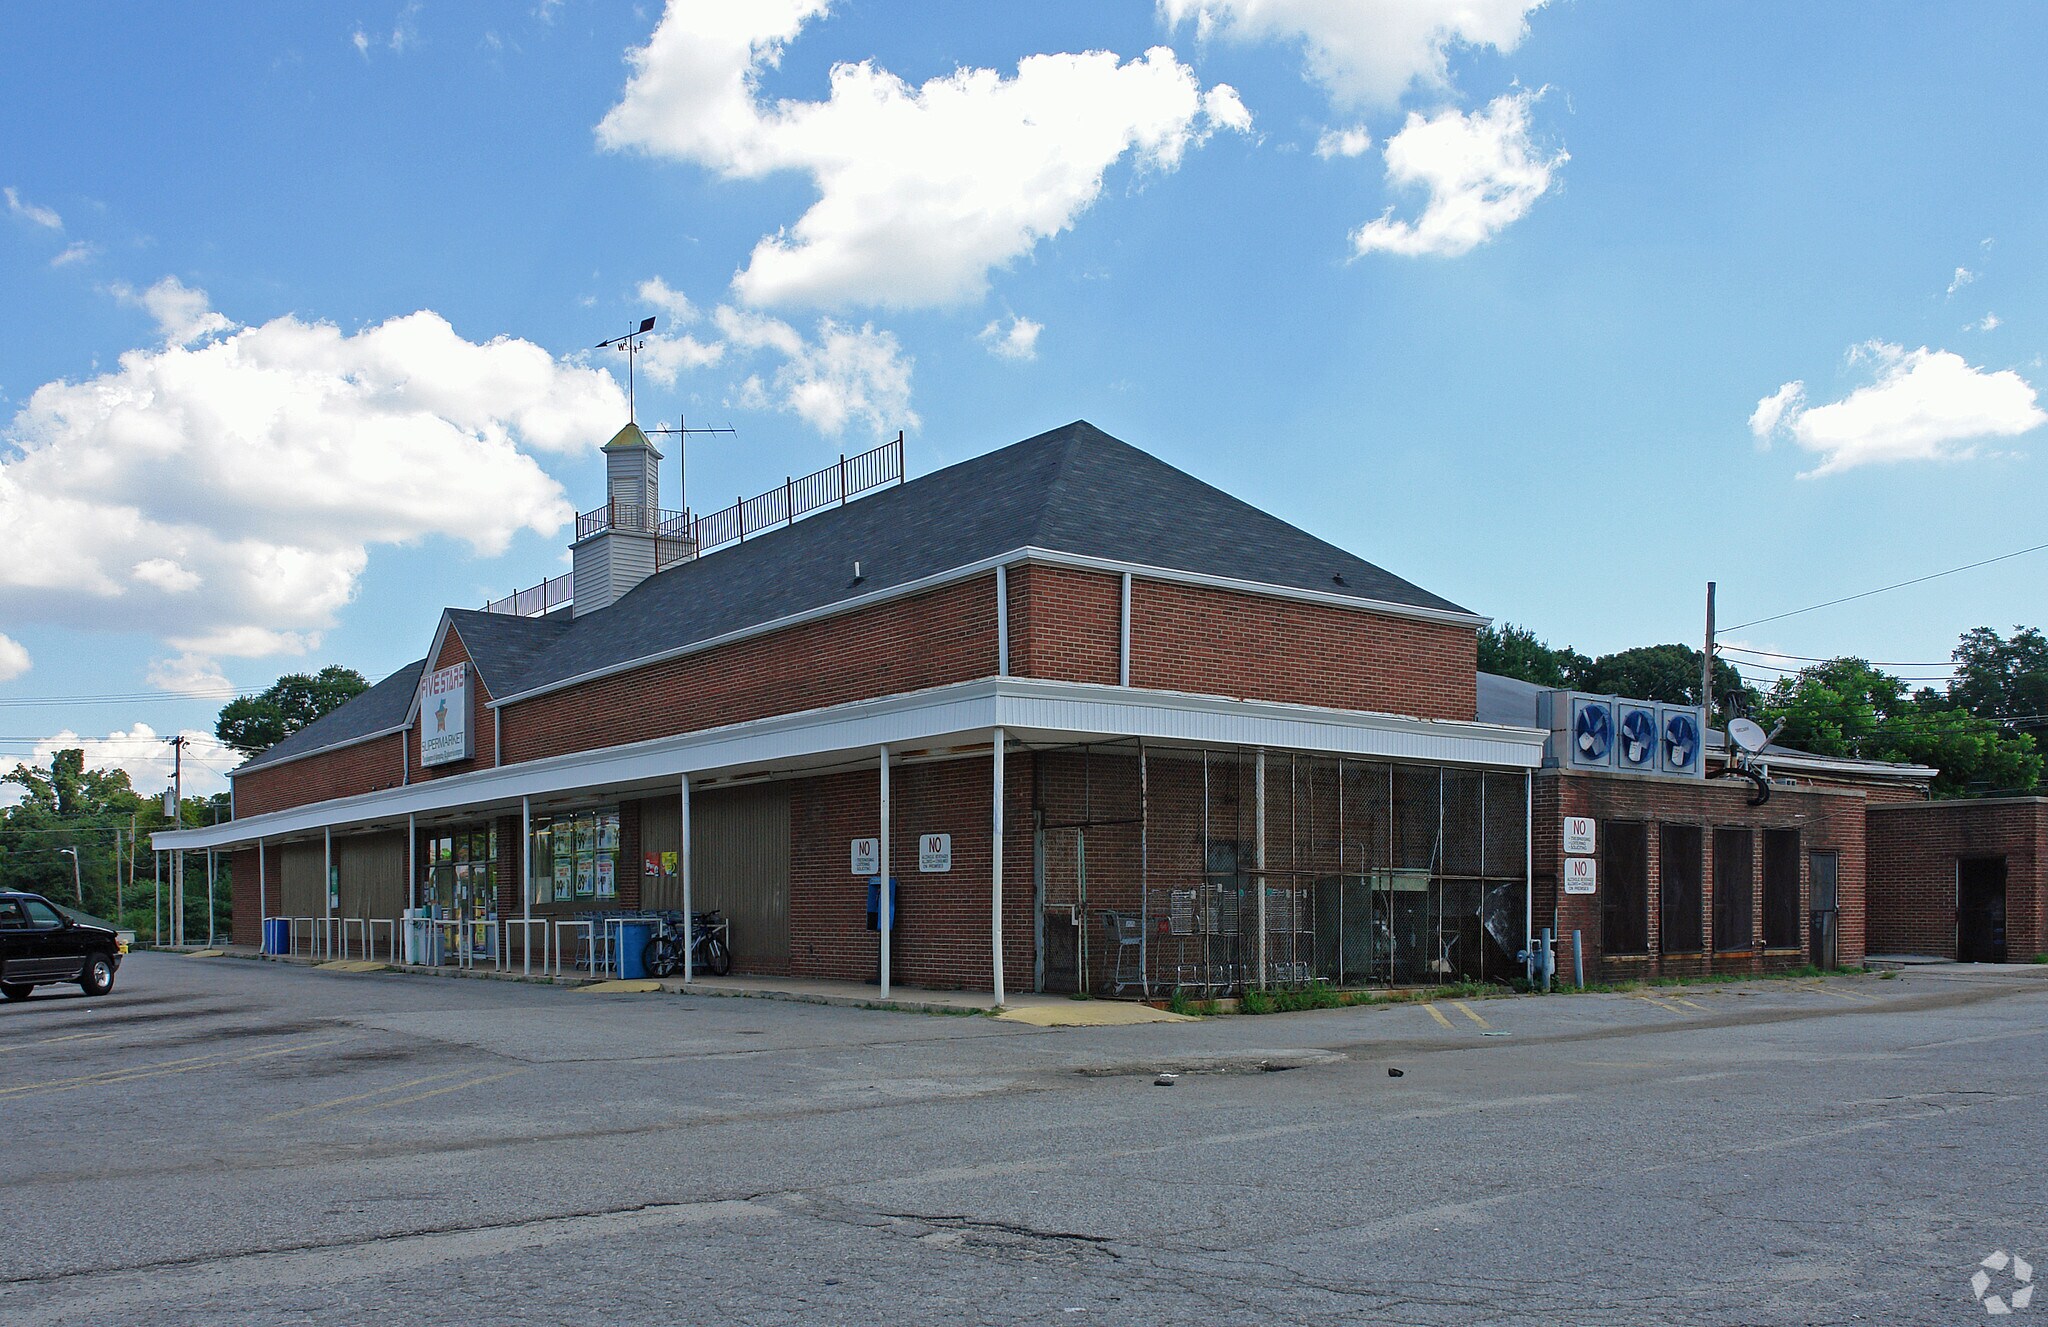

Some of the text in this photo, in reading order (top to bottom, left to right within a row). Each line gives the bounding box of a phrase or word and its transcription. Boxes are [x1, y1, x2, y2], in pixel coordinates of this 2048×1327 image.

[422, 667, 464, 698] FIVE STARS
[422, 732, 464, 752] SUPERMARKET
[1574, 820, 1586, 835] NO
[859, 841, 870, 856] NO
[929, 837, 941, 853] NO
[1574, 861, 1587, 876] NO
